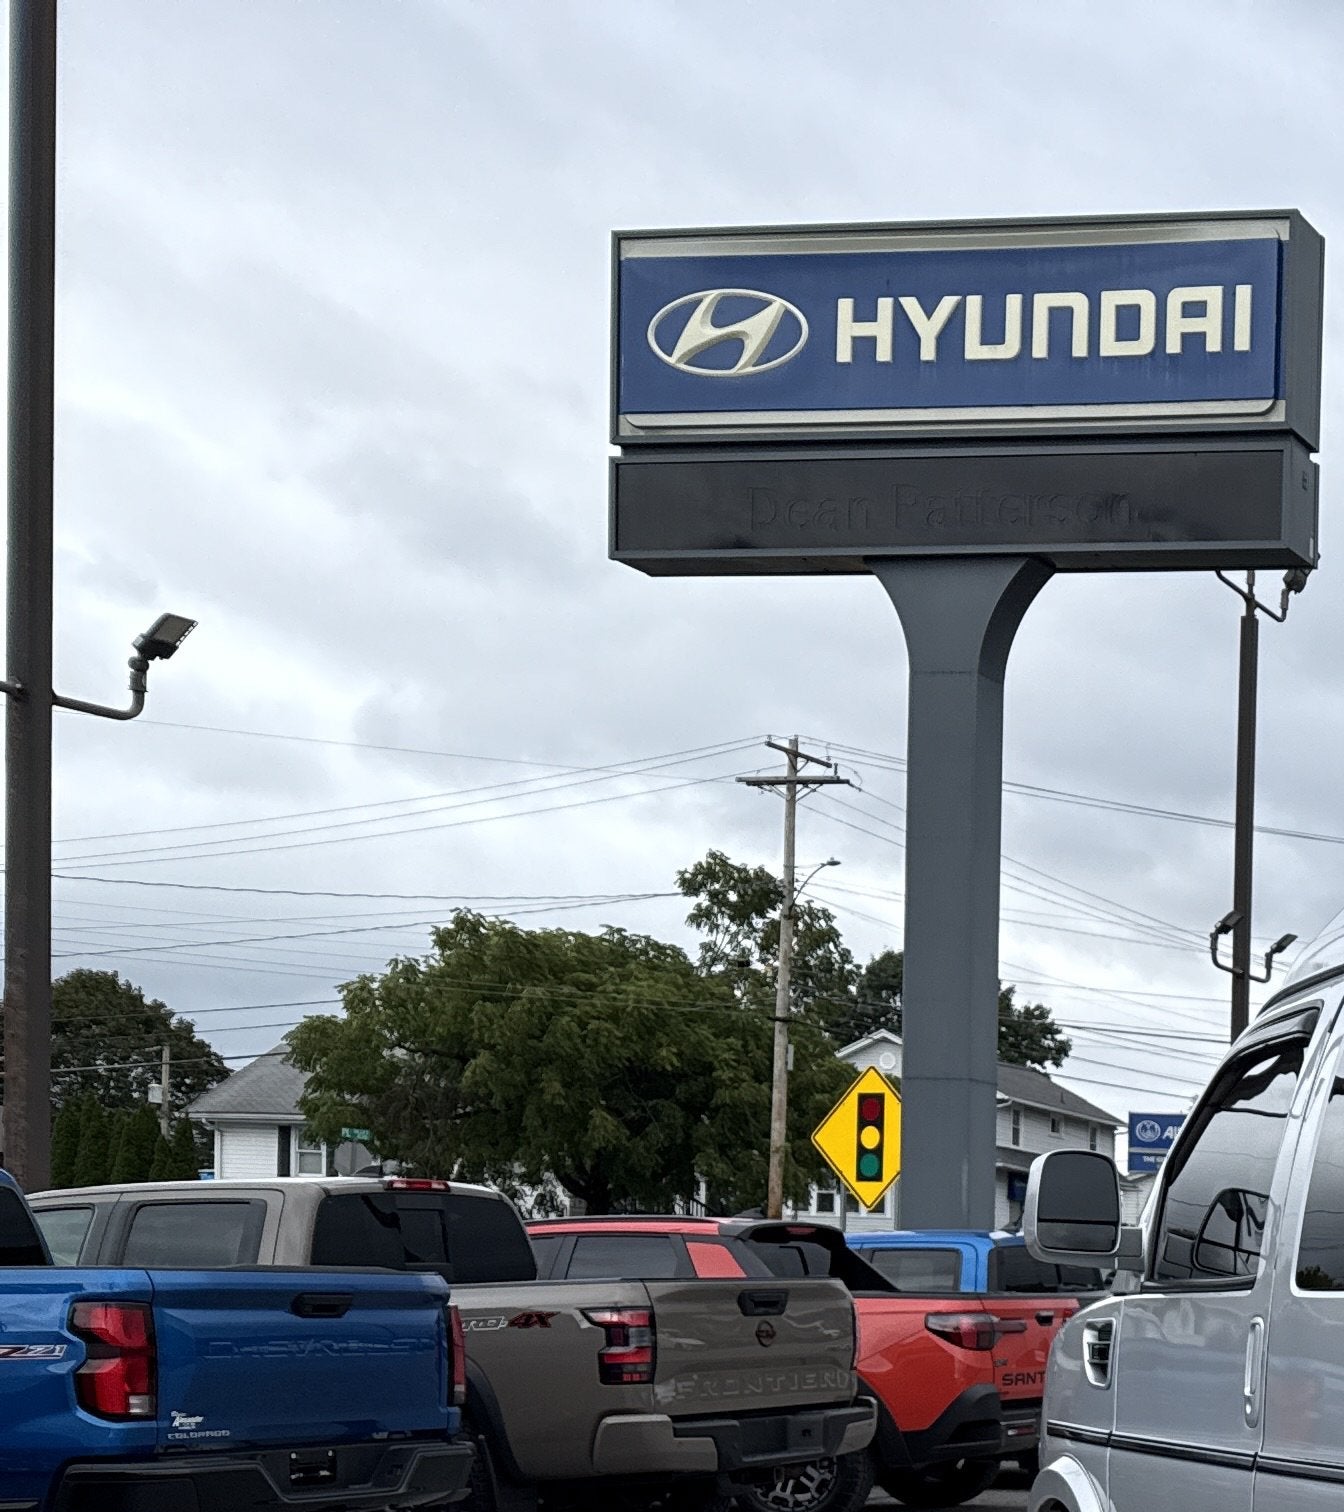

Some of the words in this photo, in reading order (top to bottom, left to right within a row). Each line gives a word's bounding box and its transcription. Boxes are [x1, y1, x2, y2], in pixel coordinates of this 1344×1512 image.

[836, 284, 1253, 364] HYUNDAI
[747, 485, 869, 532] Dean
[675, 1372, 837, 1400] FRONTIER
[167, 1430, 230, 1440] COLORADO
